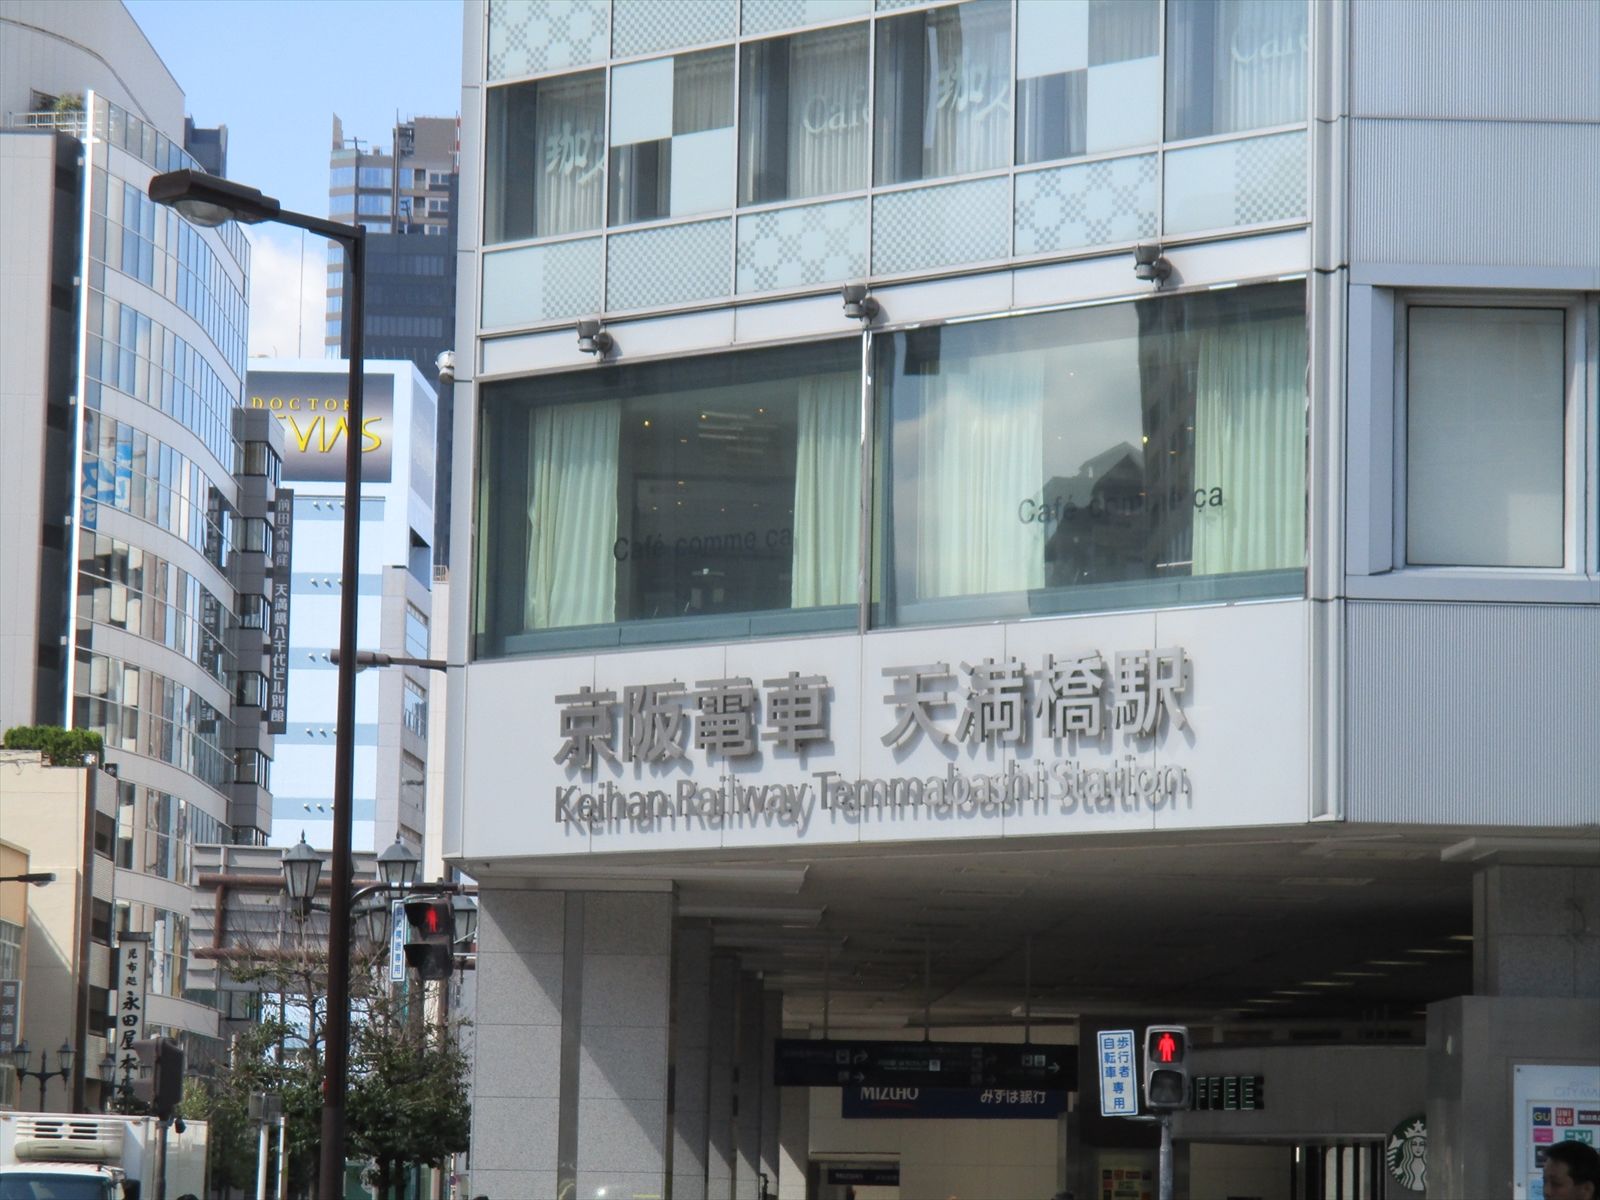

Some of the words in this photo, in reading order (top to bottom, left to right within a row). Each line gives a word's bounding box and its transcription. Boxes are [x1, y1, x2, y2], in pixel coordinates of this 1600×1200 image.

[277, 415, 382, 453] VIAS
[276, 498, 290, 567] 前田不動産
[271, 583, 288, 722] 天満橋八千代ビル別館
[554, 671, 828, 767] 京阪電車
[881, 647, 1192, 748] 天満橋駅
[555, 780, 671, 823] Keihan
[677, 774, 808, 823] Railway
[812, 759, 1041, 811] Temmabashi
[1049, 754, 1186, 802] Station
[1104, 1037, 1117, 1078] 自転車
[1117, 1037, 1130, 1078] 歩行者
[860, 1086, 920, 1101] MIZUHO
[1112, 1082, 1125, 1109] 専用
[1196, 1076, 1255, 1110] FFEE
[1533, 1111, 1551, 1122] GU
